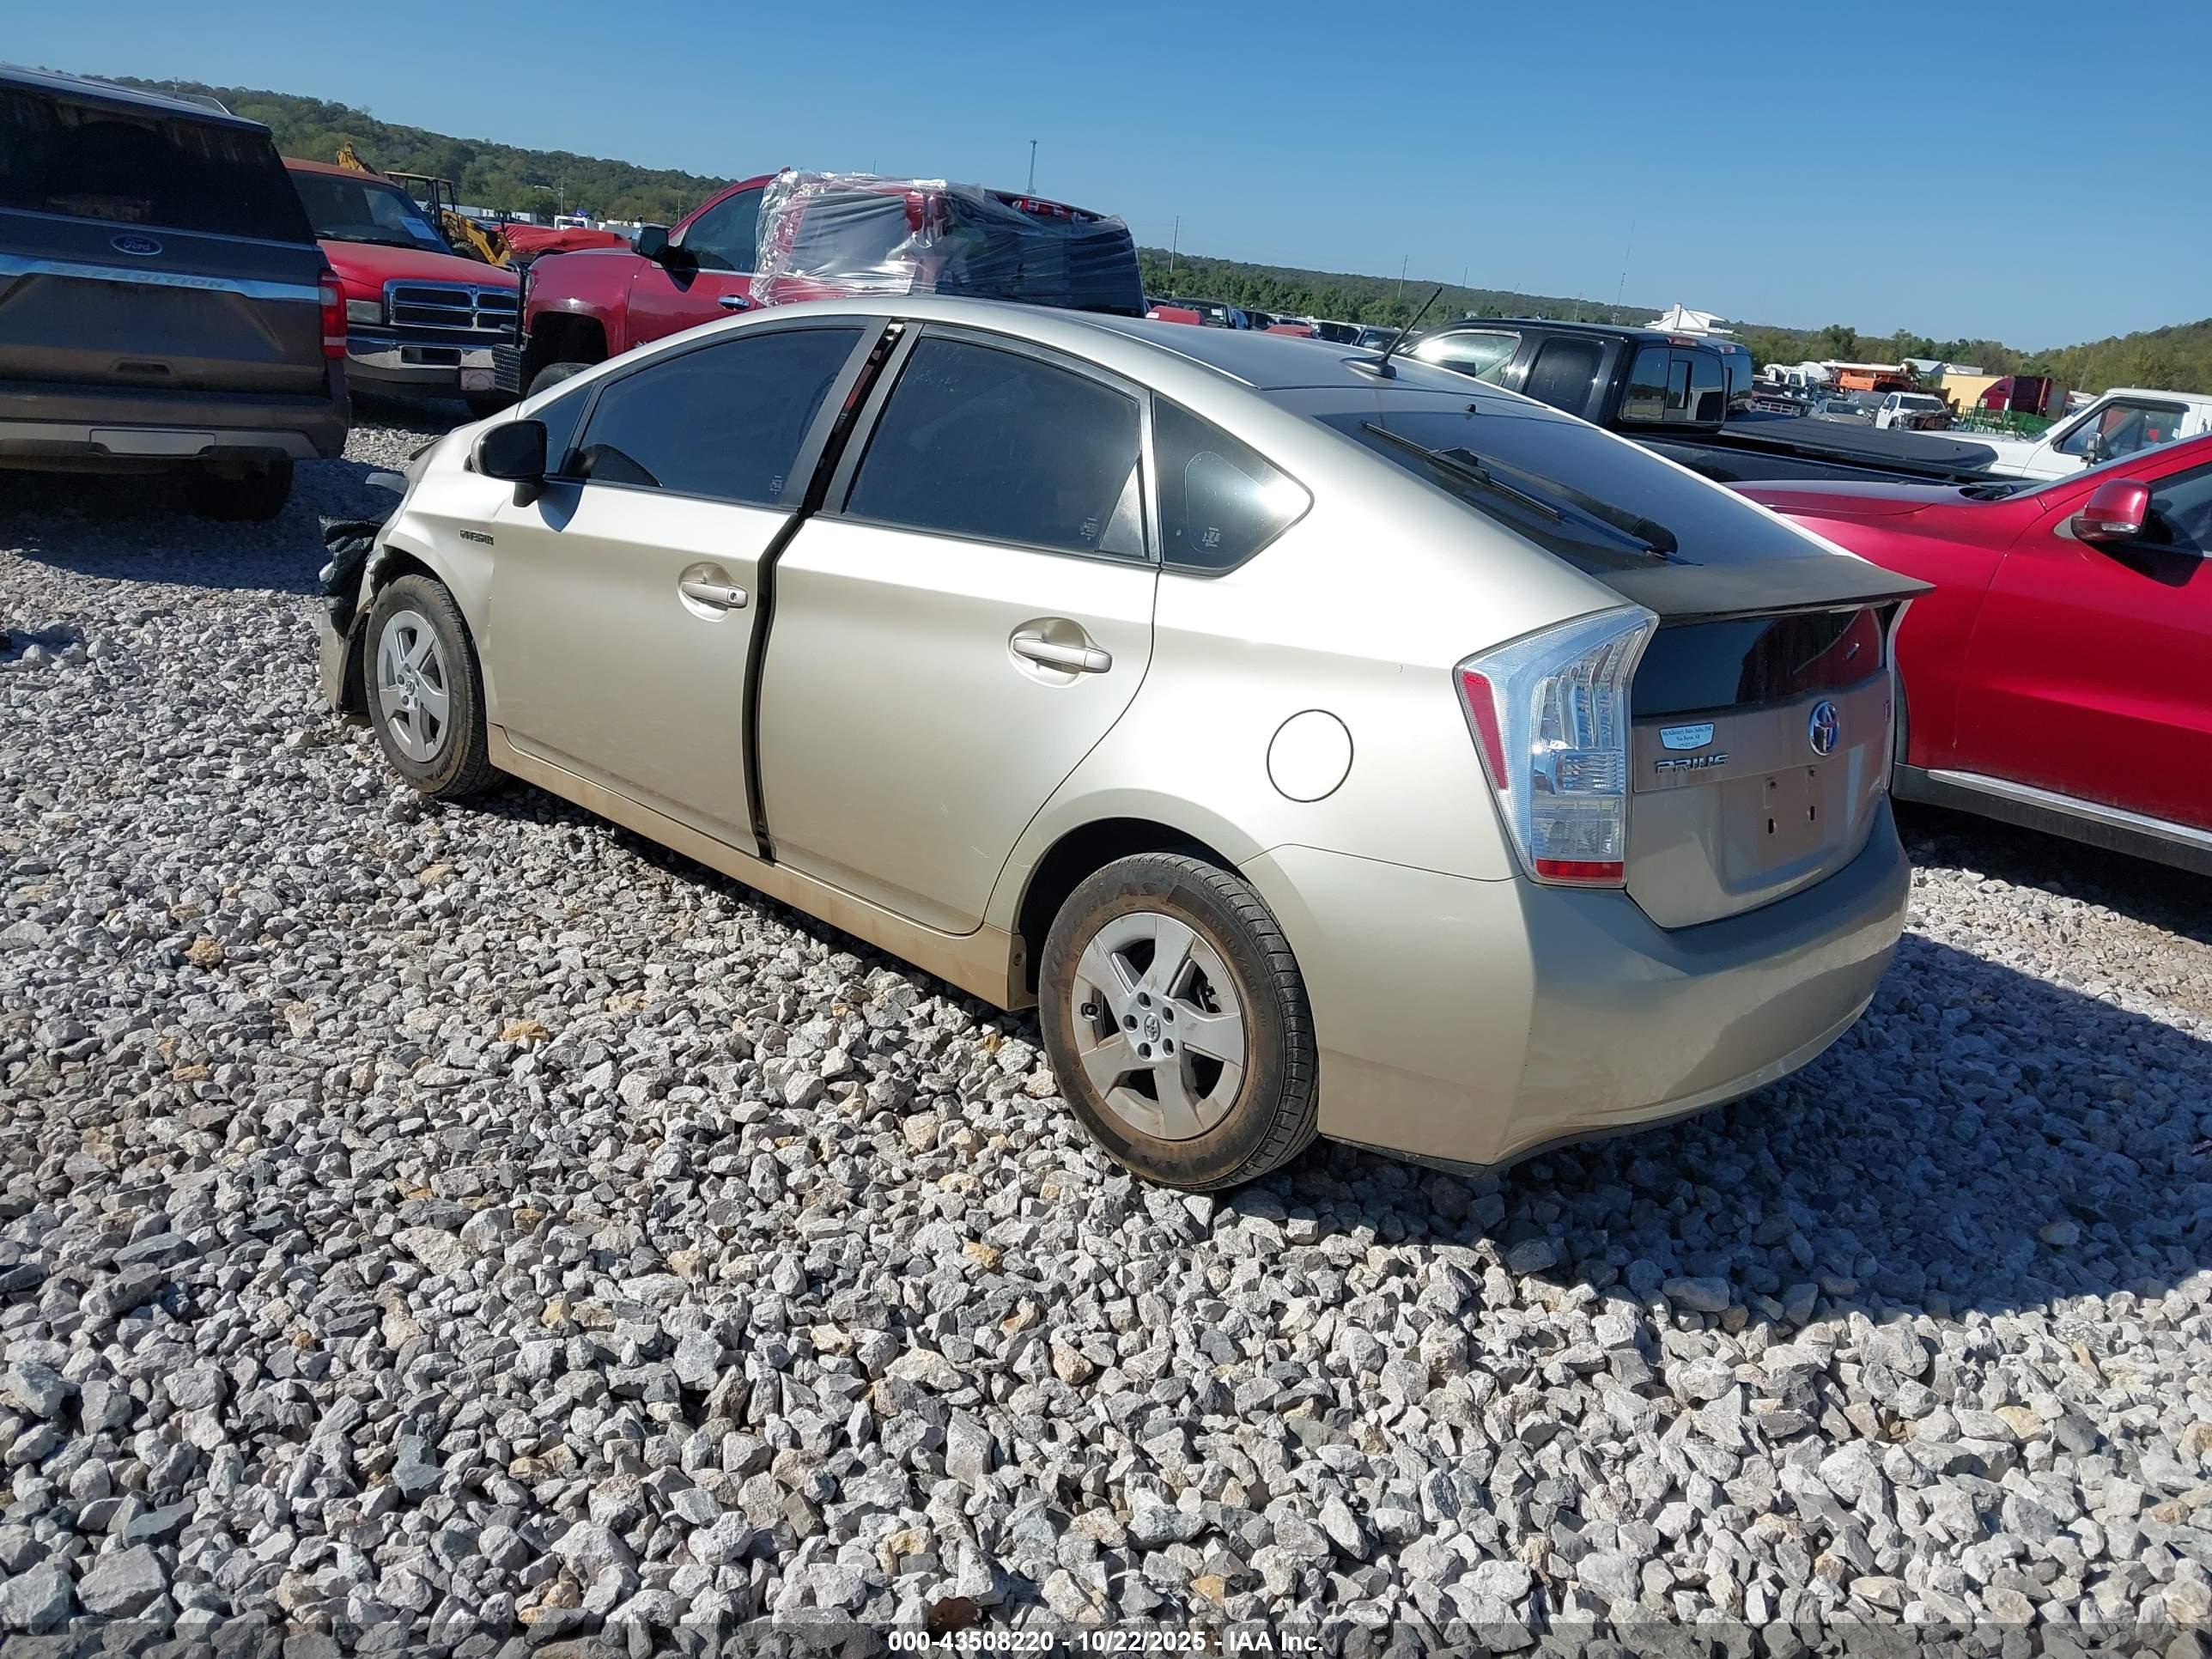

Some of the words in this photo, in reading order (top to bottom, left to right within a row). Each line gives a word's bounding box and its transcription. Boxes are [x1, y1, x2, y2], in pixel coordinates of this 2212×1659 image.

[123, 238, 152, 252] Ford
[48, 263, 227, 289] EXPEDITION
[1655, 753, 1729, 775] PRIUS
